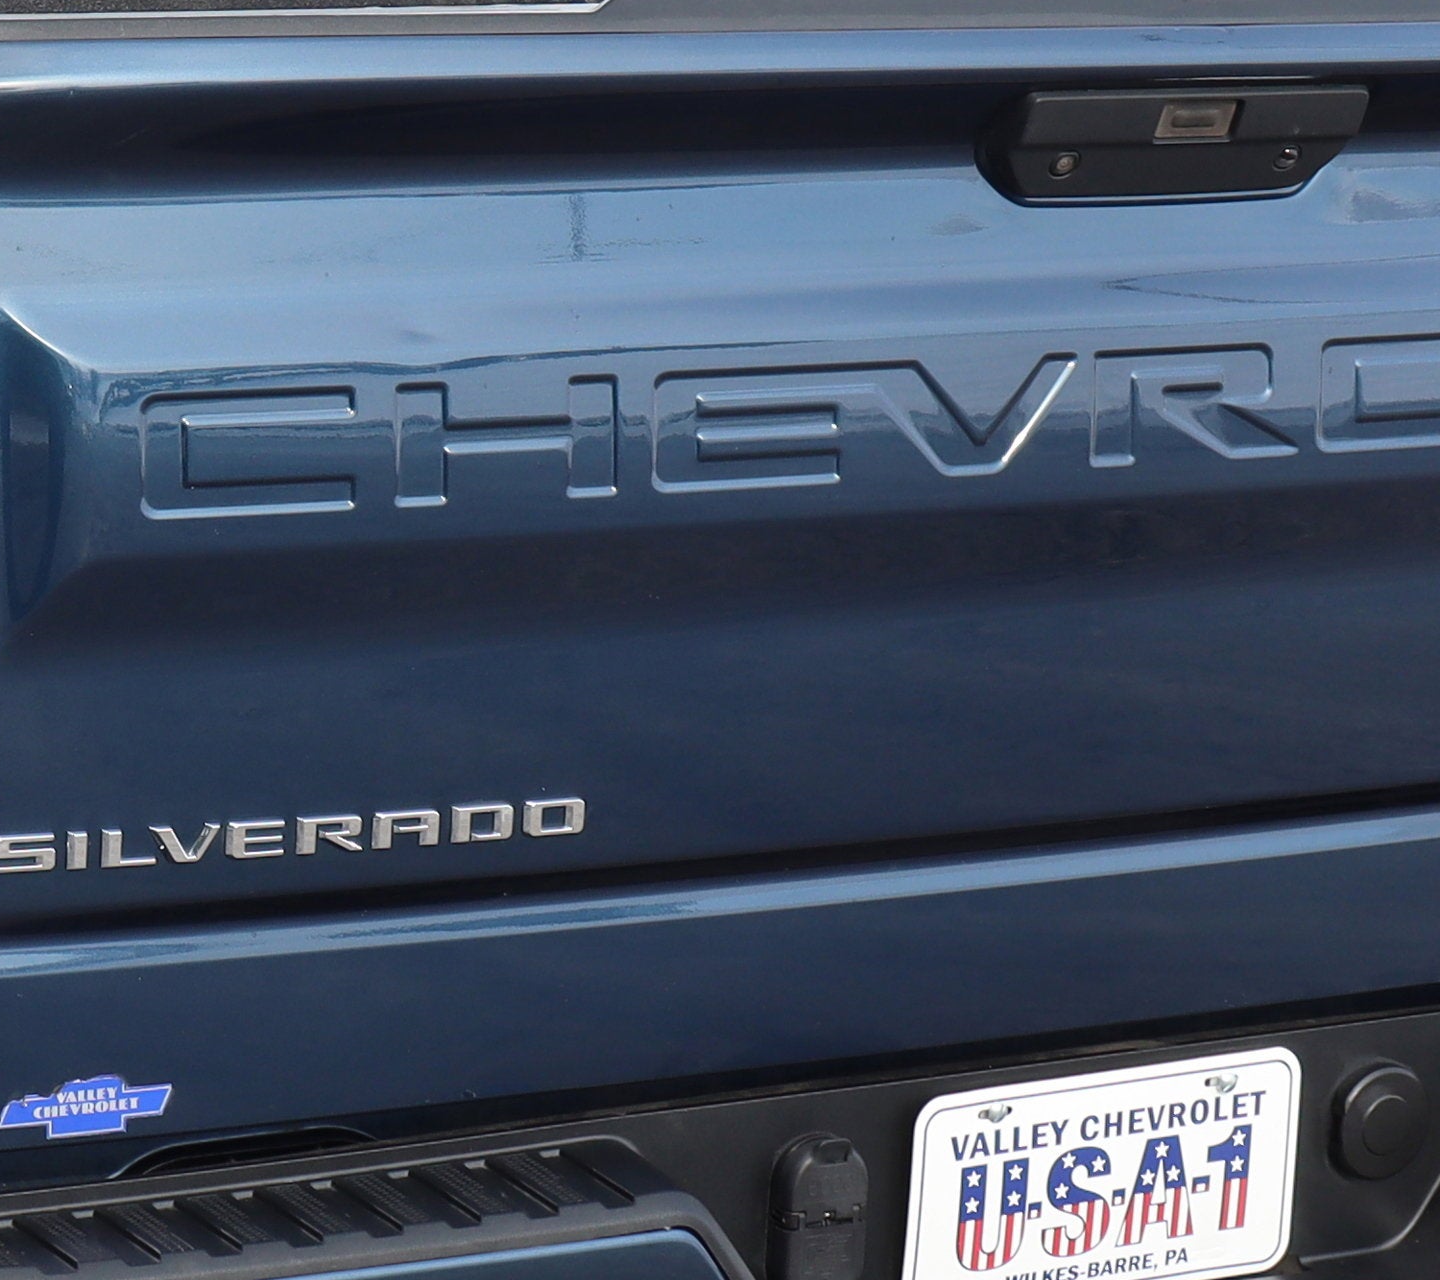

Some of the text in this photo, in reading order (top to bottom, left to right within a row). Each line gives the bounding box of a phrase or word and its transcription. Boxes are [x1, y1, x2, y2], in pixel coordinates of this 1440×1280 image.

[54, 1086, 119, 1105] VALLEY
[32, 1096, 142, 1120] CHEVROLET
[950, 1090, 1267, 1162] VALLEY CHEVROLET
[1164, 1246, 1189, 1266] PA
